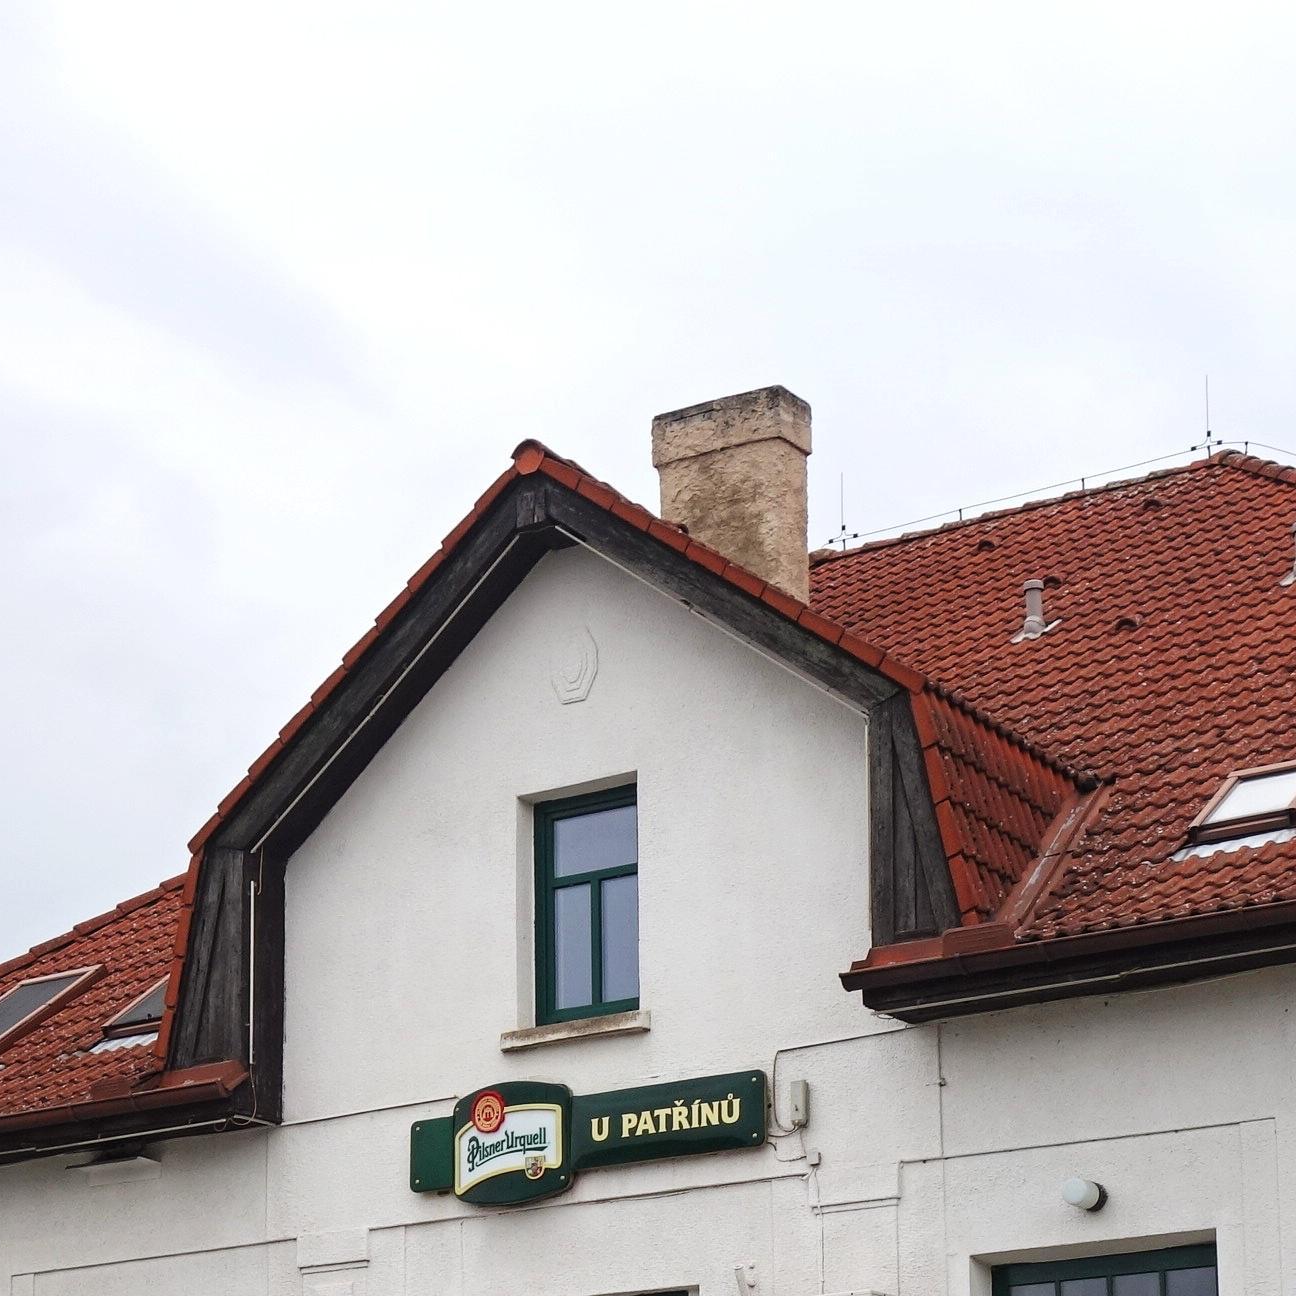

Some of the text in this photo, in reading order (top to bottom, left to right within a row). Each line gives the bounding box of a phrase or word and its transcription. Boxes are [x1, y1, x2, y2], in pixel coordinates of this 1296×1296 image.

[591, 1093, 741, 1142] U PATŘÍNŮ
[467, 1127, 546, 1172] Pilsner Urquell
